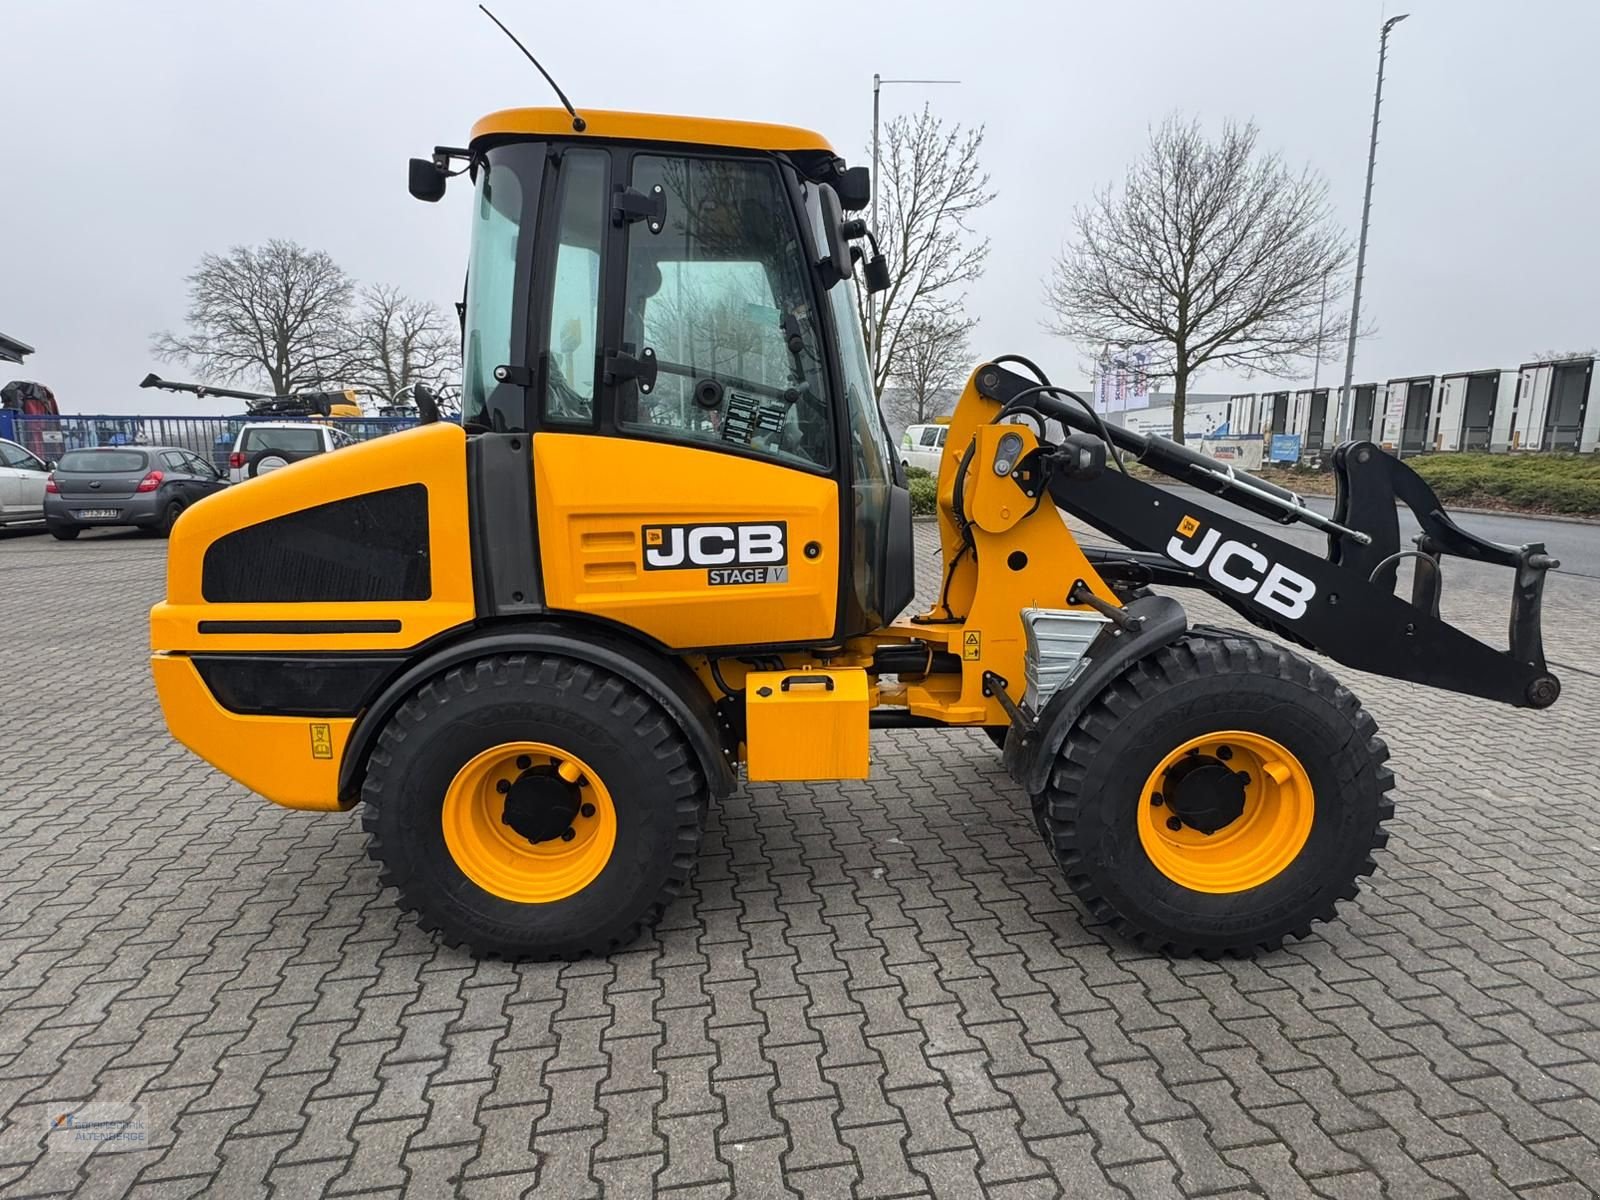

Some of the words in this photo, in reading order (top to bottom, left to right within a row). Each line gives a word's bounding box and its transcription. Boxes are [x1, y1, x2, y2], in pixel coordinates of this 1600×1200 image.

[646, 525, 784, 567] JCB
[710, 568, 764, 584] STAGE
[773, 568, 784, 582] V
[1166, 527, 1317, 620] JCB
